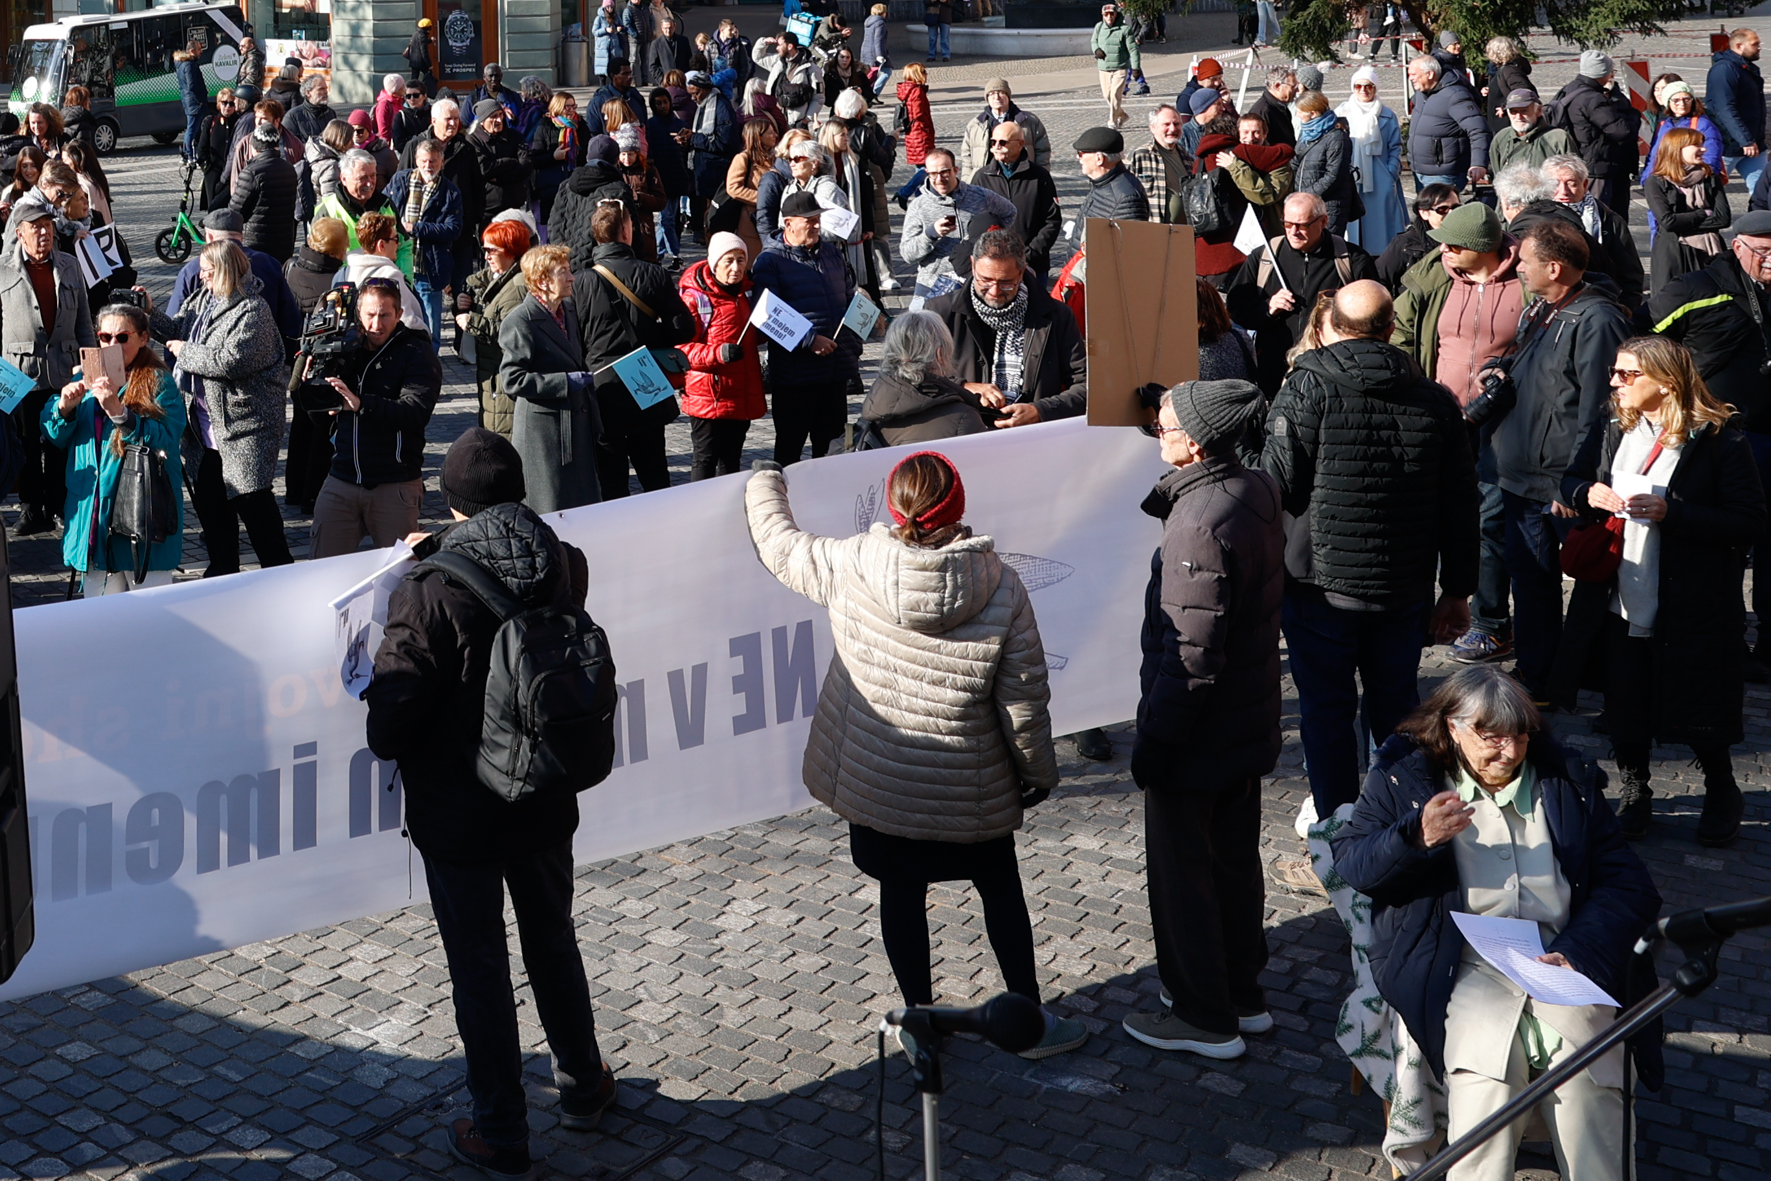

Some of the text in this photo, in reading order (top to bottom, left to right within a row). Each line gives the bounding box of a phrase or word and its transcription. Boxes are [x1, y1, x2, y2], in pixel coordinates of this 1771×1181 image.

[215, 60, 238, 68] KAVALIR
[771, 306, 783, 317] NE
[771, 317, 796, 338] mojem
